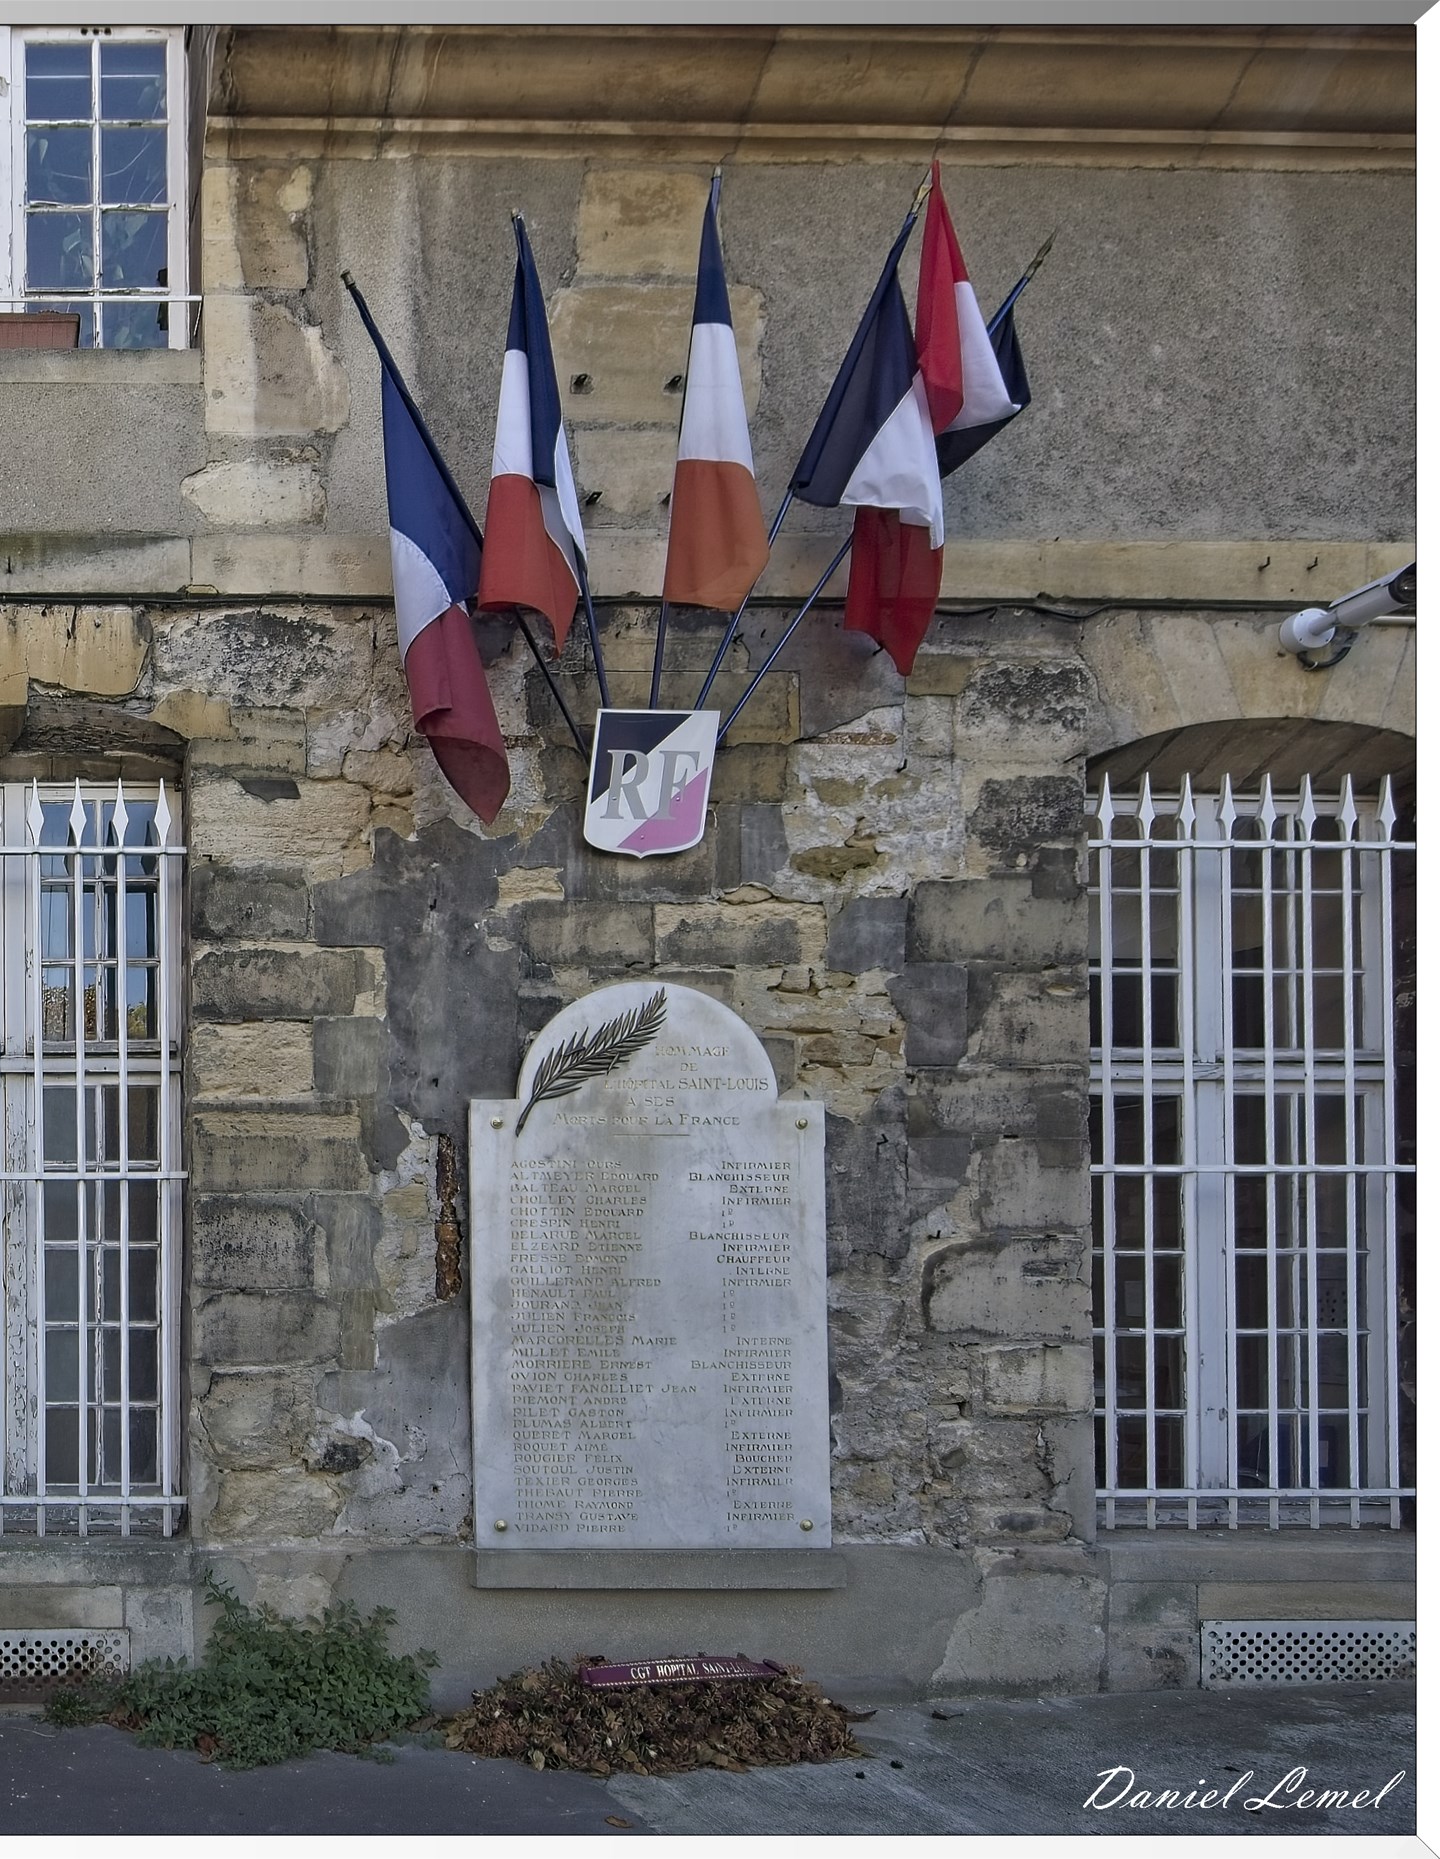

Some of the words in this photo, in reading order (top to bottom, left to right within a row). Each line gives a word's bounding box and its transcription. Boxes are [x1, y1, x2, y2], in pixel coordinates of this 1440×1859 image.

[599, 749, 701, 820] RF
[680, 1063, 698, 1072] DE
[678, 1077, 769, 1091] SAINT-LOUIS
[645, 1096, 675, 1107] SES
[680, 1113, 741, 1126] FRANCE
[510, 1160, 577, 1169] AGOSTINI
[587, 1160, 622, 1169] OURS
[722, 1160, 791, 1170] INFIRMIER
[510, 1171, 594, 1181] ALTMEYER
[600, 1171, 659, 1181] EDOUARD
[689, 1172, 791, 1182] BLANCHISSEUR
[510, 1183, 578, 1193] BALTEAU
[584, 1183, 641, 1193] MARCEL
[729, 1184, 789, 1194] EXTERNE
[510, 1195, 577, 1205] CHOLLEY
[586, 1195, 647, 1205] CHARLES
[722, 1196, 792, 1206] INFIRMIER
[510, 1207, 576, 1217] CHOTTIN
[584, 1207, 644, 1217] EDOUARD
[510, 1219, 571, 1229] CRESPIN
[579, 1219, 620, 1229] HENRI
[511, 1231, 579, 1240] DELARUE
[584, 1231, 641, 1240] MARCEL
[689, 1231, 790, 1240] BLANCHISSEUR
[722, 1242, 791, 1252] INFIRMIER
[511, 1254, 567, 1263] FRESSE
[575, 1254, 628, 1263] EDMOND
[716, 1254, 791, 1264] CHAUFFEUR
[510, 1265, 572, 1274] GALLIOT
[581, 1265, 622, 1274] HENRI
[735, 1266, 790, 1276] INTERNE
[611, 1278, 661, 1287] ALFRED
[722, 1277, 791, 1287] INFIRMIER
[511, 1289, 576, 1299] HENAULT
[510, 1312, 565, 1322] JULIEN
[510, 1324, 566, 1334] JULIEN
[575, 1324, 625, 1334] JOSEPH
[511, 1336, 625, 1346] MARCORELLES
[632, 1336, 678, 1346] MARIE
[736, 1336, 793, 1346] INTERNE
[511, 1348, 570, 1358] MILLET
[577, 1348, 621, 1358] EMILE
[723, 1348, 792, 1358] INFIRMIER
[600, 1360, 653, 1370] ERNEST
[691, 1360, 792, 1370] BLANCHISSEUR
[511, 1372, 557, 1381] OVION
[564, 1372, 628, 1381] CHARLES
[731, 1372, 791, 1382] EXTERNE
[512, 1384, 564, 1393] PAVIET
[661, 1384, 697, 1393] JEAN
[723, 1384, 794, 1394] INFIRMIER
[512, 1395, 577, 1405] PIEMONT
[513, 1407, 561, 1417] PILET
[568, 1407, 625, 1417] GASTON
[513, 1419, 572, 1429] PLUMAS
[579, 1419, 633, 1429] ALBERT
[512, 1430, 571, 1440] QUERET
[577, 1430, 637, 1440] MARCEL
[731, 1431, 792, 1440] EXTERNE
[513, 1442, 568, 1452] ROQUET
[725, 1443, 793, 1453] INFIRMIER
[513, 1454, 577, 1463] ROUGIER
[735, 1454, 793, 1463] BOUCHER
[513, 1465, 577, 1475] SOUTOUL
[586, 1465, 634, 1475] JUSTIN
[514, 1477, 571, 1487] TEXIER
[577, 1477, 639, 1487] GEORGES
[726, 1477, 794, 1487] INFIRMIER
[593, 1488, 643, 1498] PIERRE
[574, 1500, 634, 1510] RAYMOND
[732, 1500, 794, 1510] EXTERNE
[579, 1512, 639, 1521] GUSTAVE
[726, 1512, 795, 1522] INFIRMIER
[514, 1524, 570, 1534] VIDARD
[576, 1524, 626, 1534] PIERRE
[630, 1666, 652, 1680] CGT
[656, 1662, 700, 1678] HOPITAL
